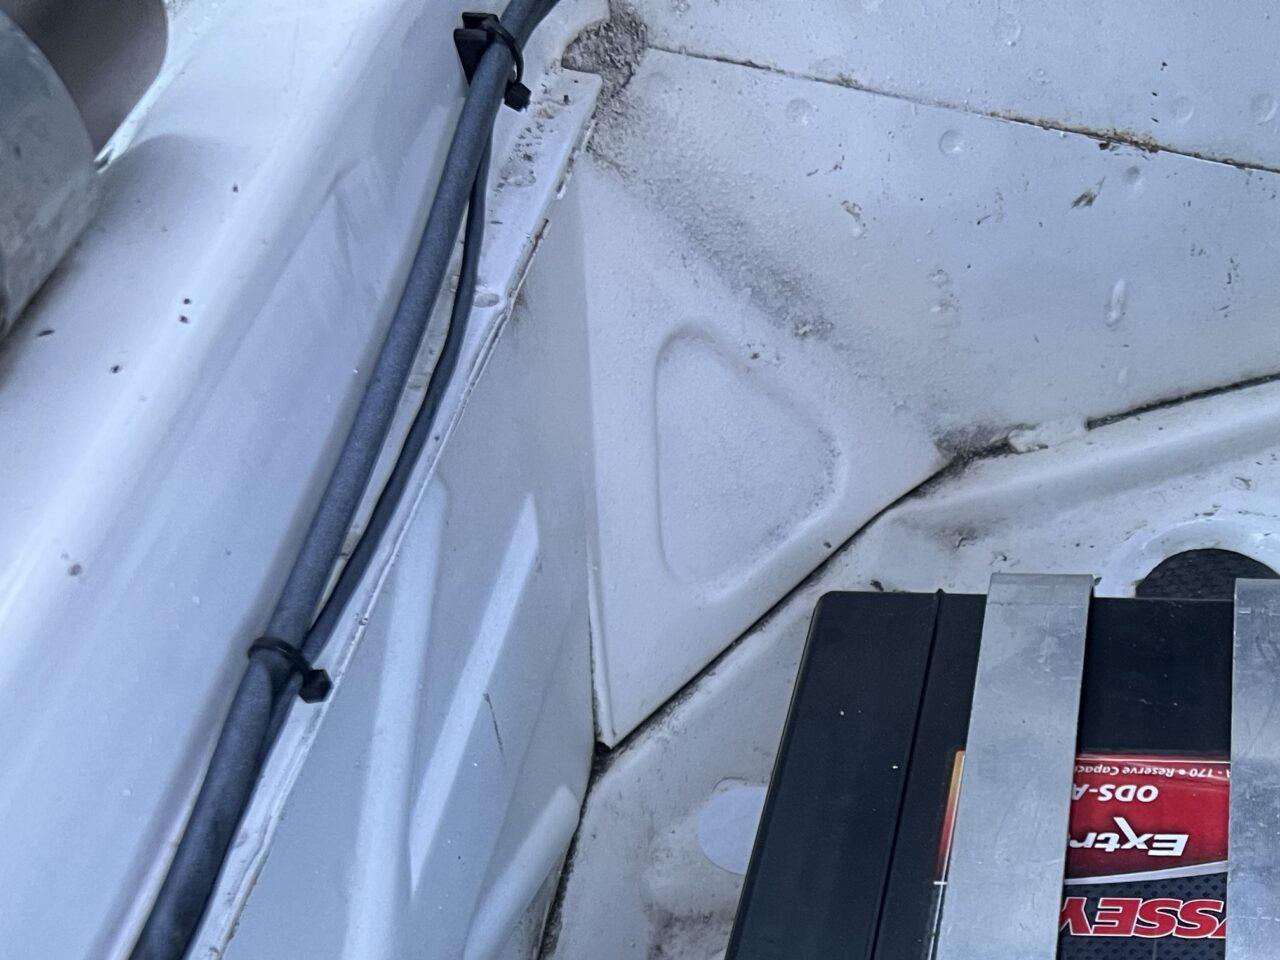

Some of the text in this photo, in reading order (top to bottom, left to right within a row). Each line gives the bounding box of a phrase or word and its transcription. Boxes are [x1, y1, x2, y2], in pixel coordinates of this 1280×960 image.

[1123, 766, 1175, 778] Reserve
[1189, 768, 1213, 778] 170
[1068, 816, 1188, 856] Extr
